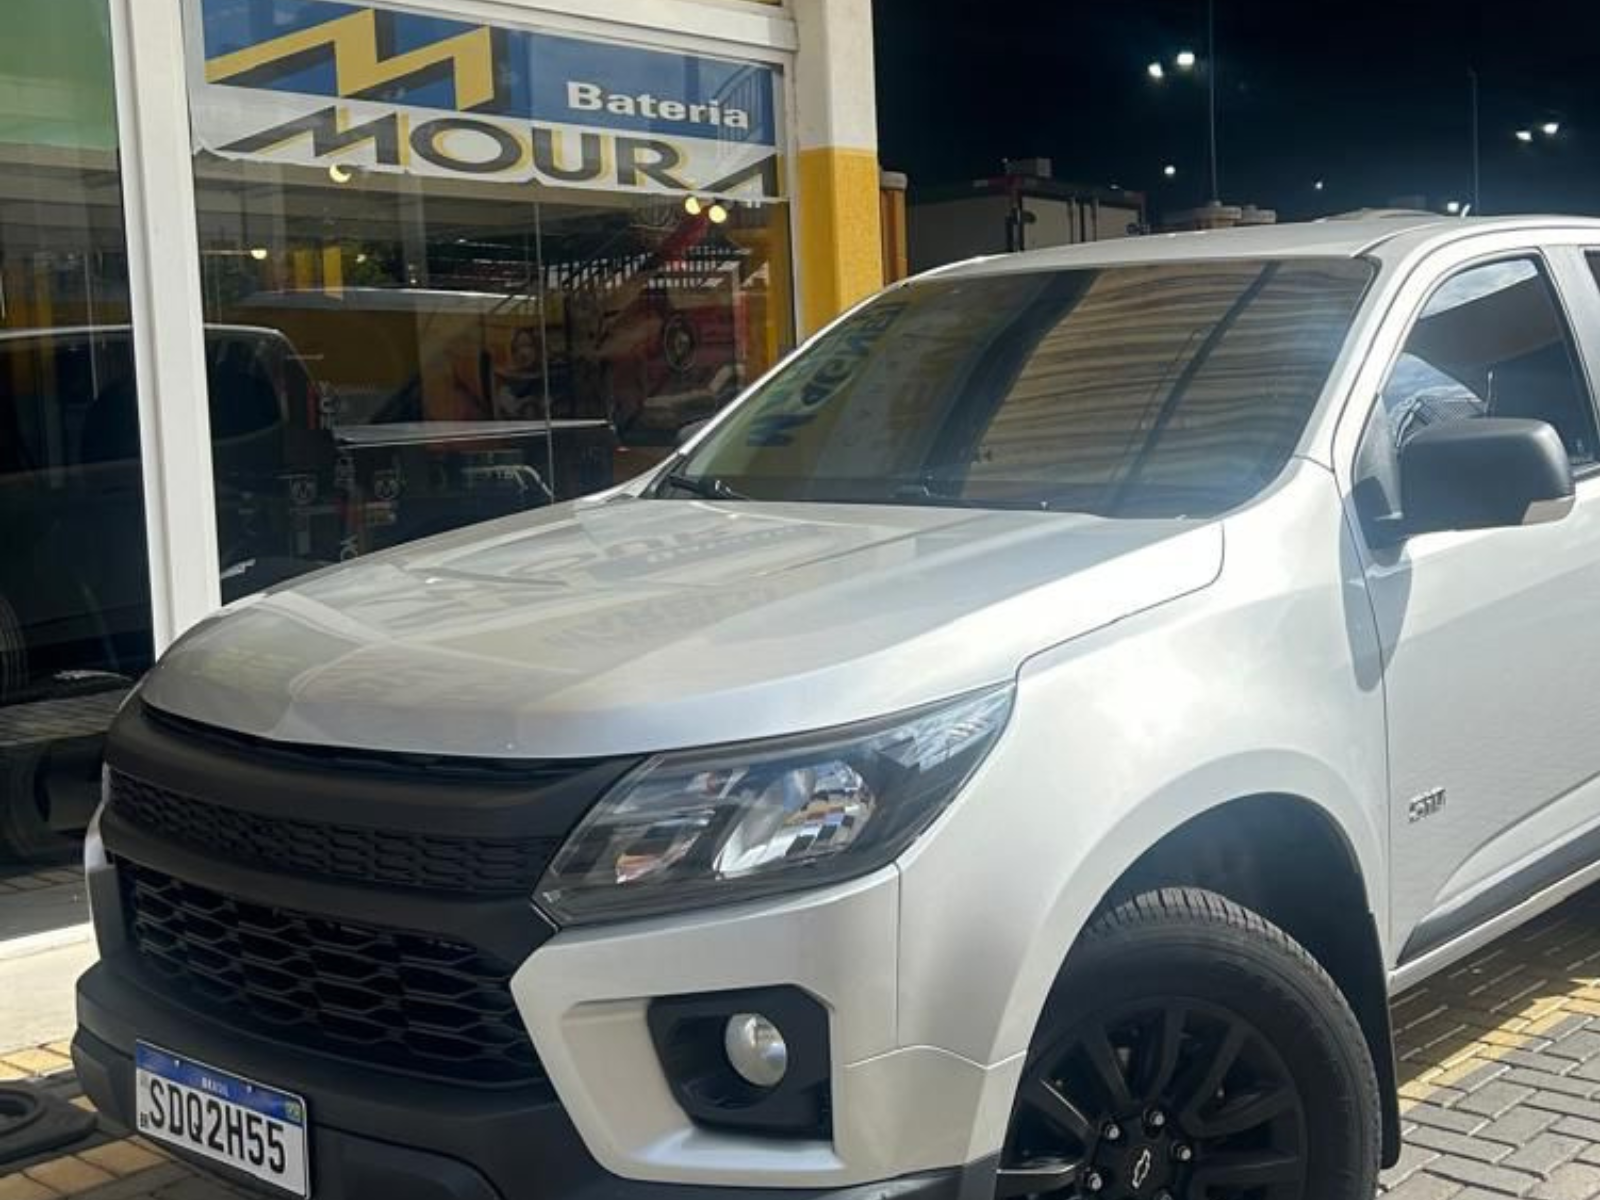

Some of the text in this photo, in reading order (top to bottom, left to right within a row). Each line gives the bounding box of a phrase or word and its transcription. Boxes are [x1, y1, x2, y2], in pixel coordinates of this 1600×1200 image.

[566, 80, 749, 129] Bateria
[213, 105, 779, 197] MOURA
[150, 1078, 286, 1174] SDQ2H55
